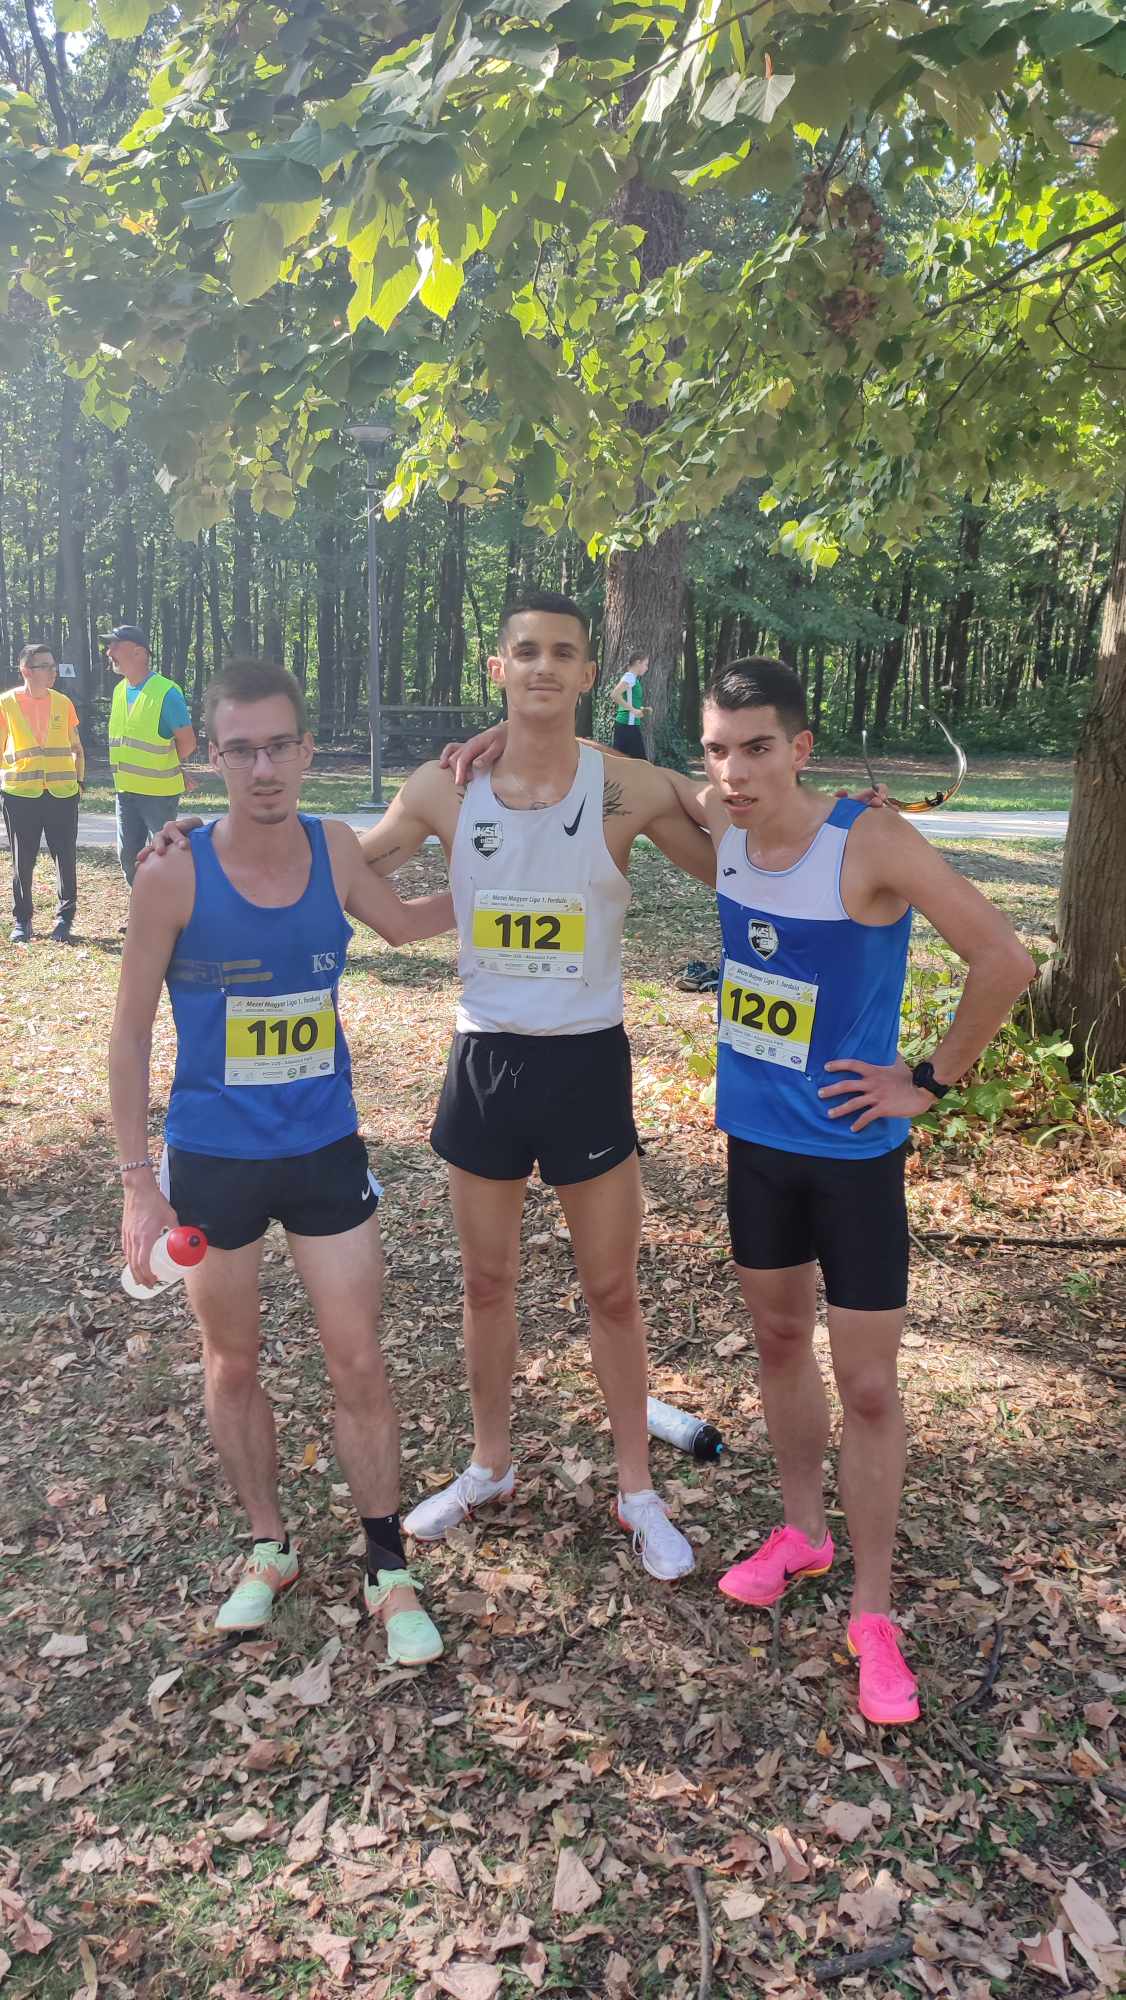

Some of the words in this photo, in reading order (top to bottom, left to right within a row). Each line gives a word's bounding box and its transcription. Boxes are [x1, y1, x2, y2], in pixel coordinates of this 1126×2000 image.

[494, 914, 561, 949] 112
[730, 988, 797, 1036] 120
[247, 1016, 319, 1056] 110
